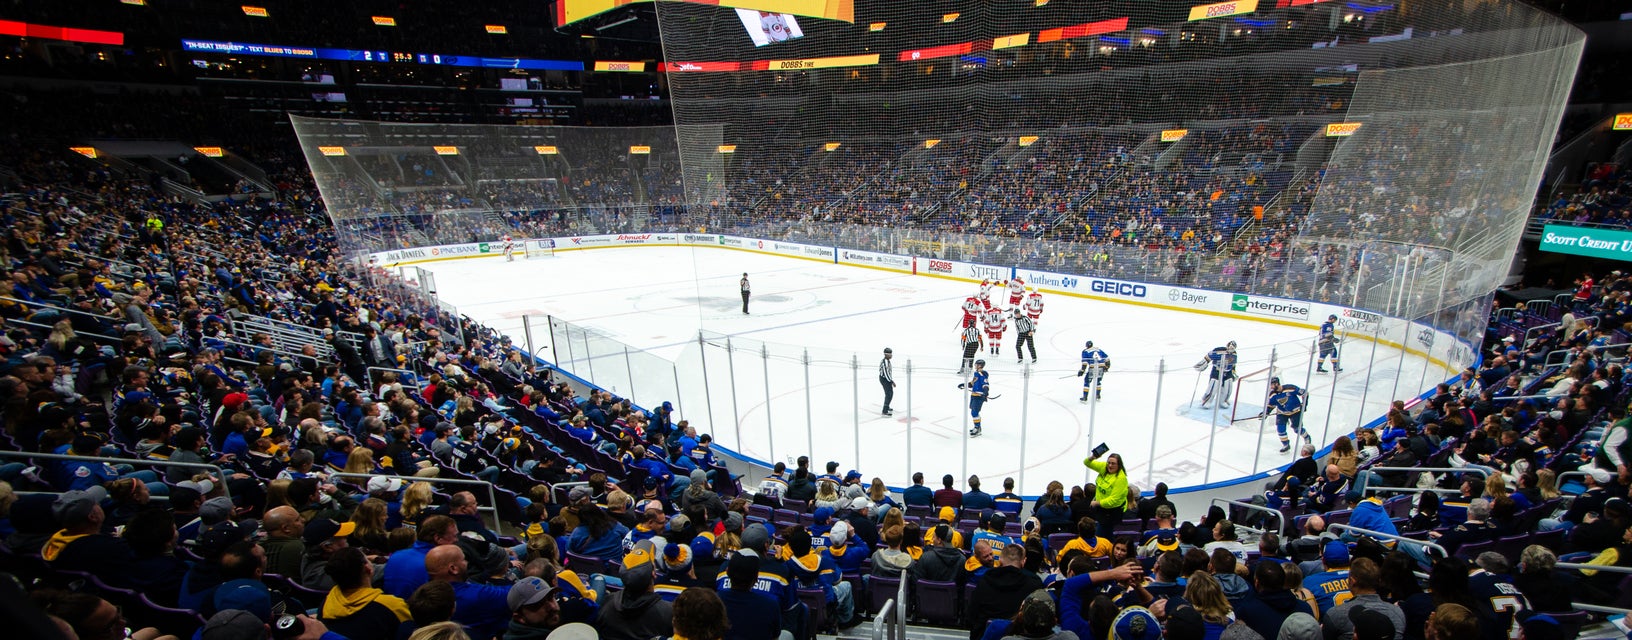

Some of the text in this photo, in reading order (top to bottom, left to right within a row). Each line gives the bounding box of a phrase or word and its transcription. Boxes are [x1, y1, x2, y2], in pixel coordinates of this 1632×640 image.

[1207, 3, 1236, 14] DOBBS
[364, 51, 372, 61] 2
[433, 55, 441, 64] 0
[780, 60, 803, 69] DOBBS
[386, 250, 401, 262] JACK
[929, 260, 952, 270] DOBBS
[970, 264, 1001, 281] STIFEL
[1028, 273, 1059, 287] Anthem
[1091, 280, 1147, 297] GEICO
[1182, 291, 1207, 303] Bayer
[1236, 298, 1308, 316] enterprise
[991, 314, 998, 323] 14
